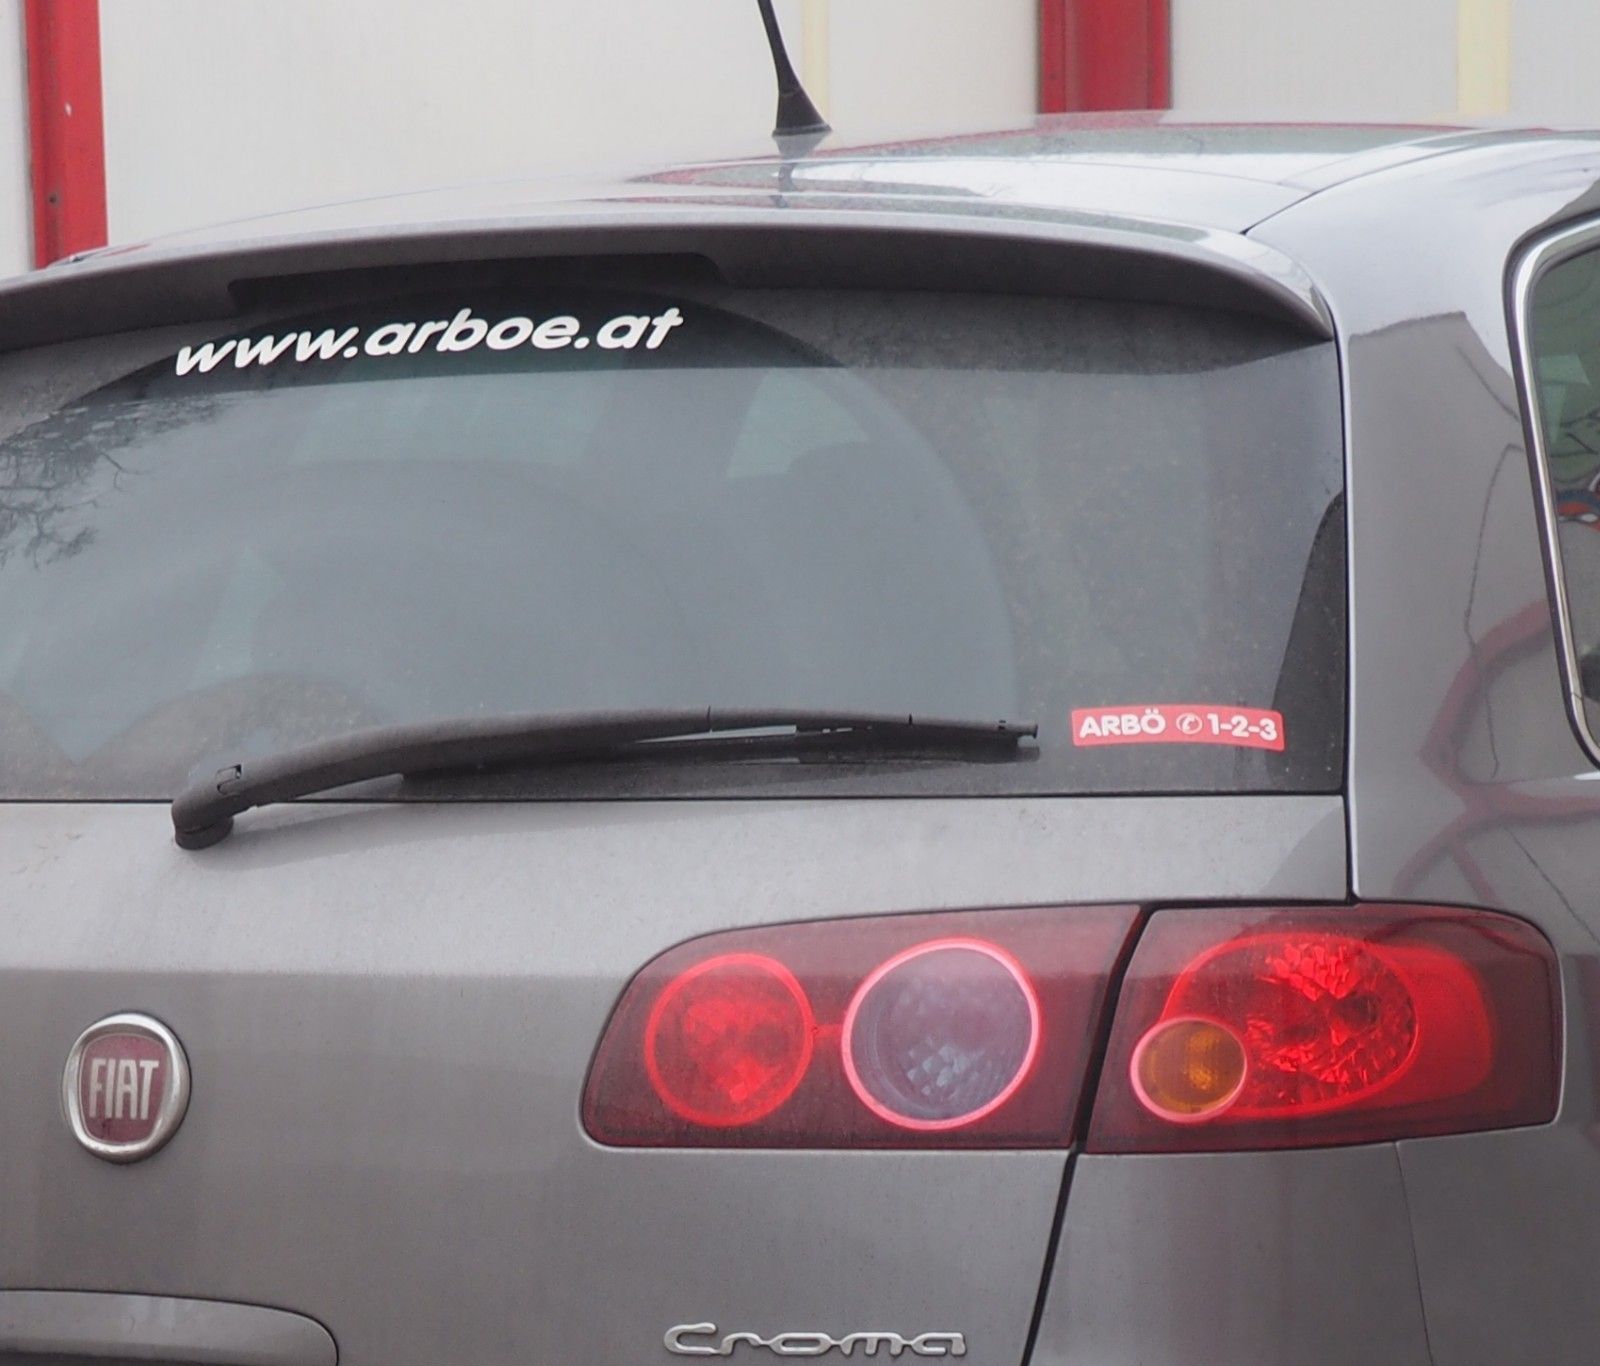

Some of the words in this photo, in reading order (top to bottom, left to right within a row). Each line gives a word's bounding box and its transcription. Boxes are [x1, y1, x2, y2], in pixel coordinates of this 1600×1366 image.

[175, 307, 683, 376] www.arboe.at
[1079, 708, 1166, 738] ARBÖ
[1207, 713, 1277, 741] 1-2-3
[89, 1058, 160, 1120] FIAT
[664, 1322, 967, 1356] Croma
